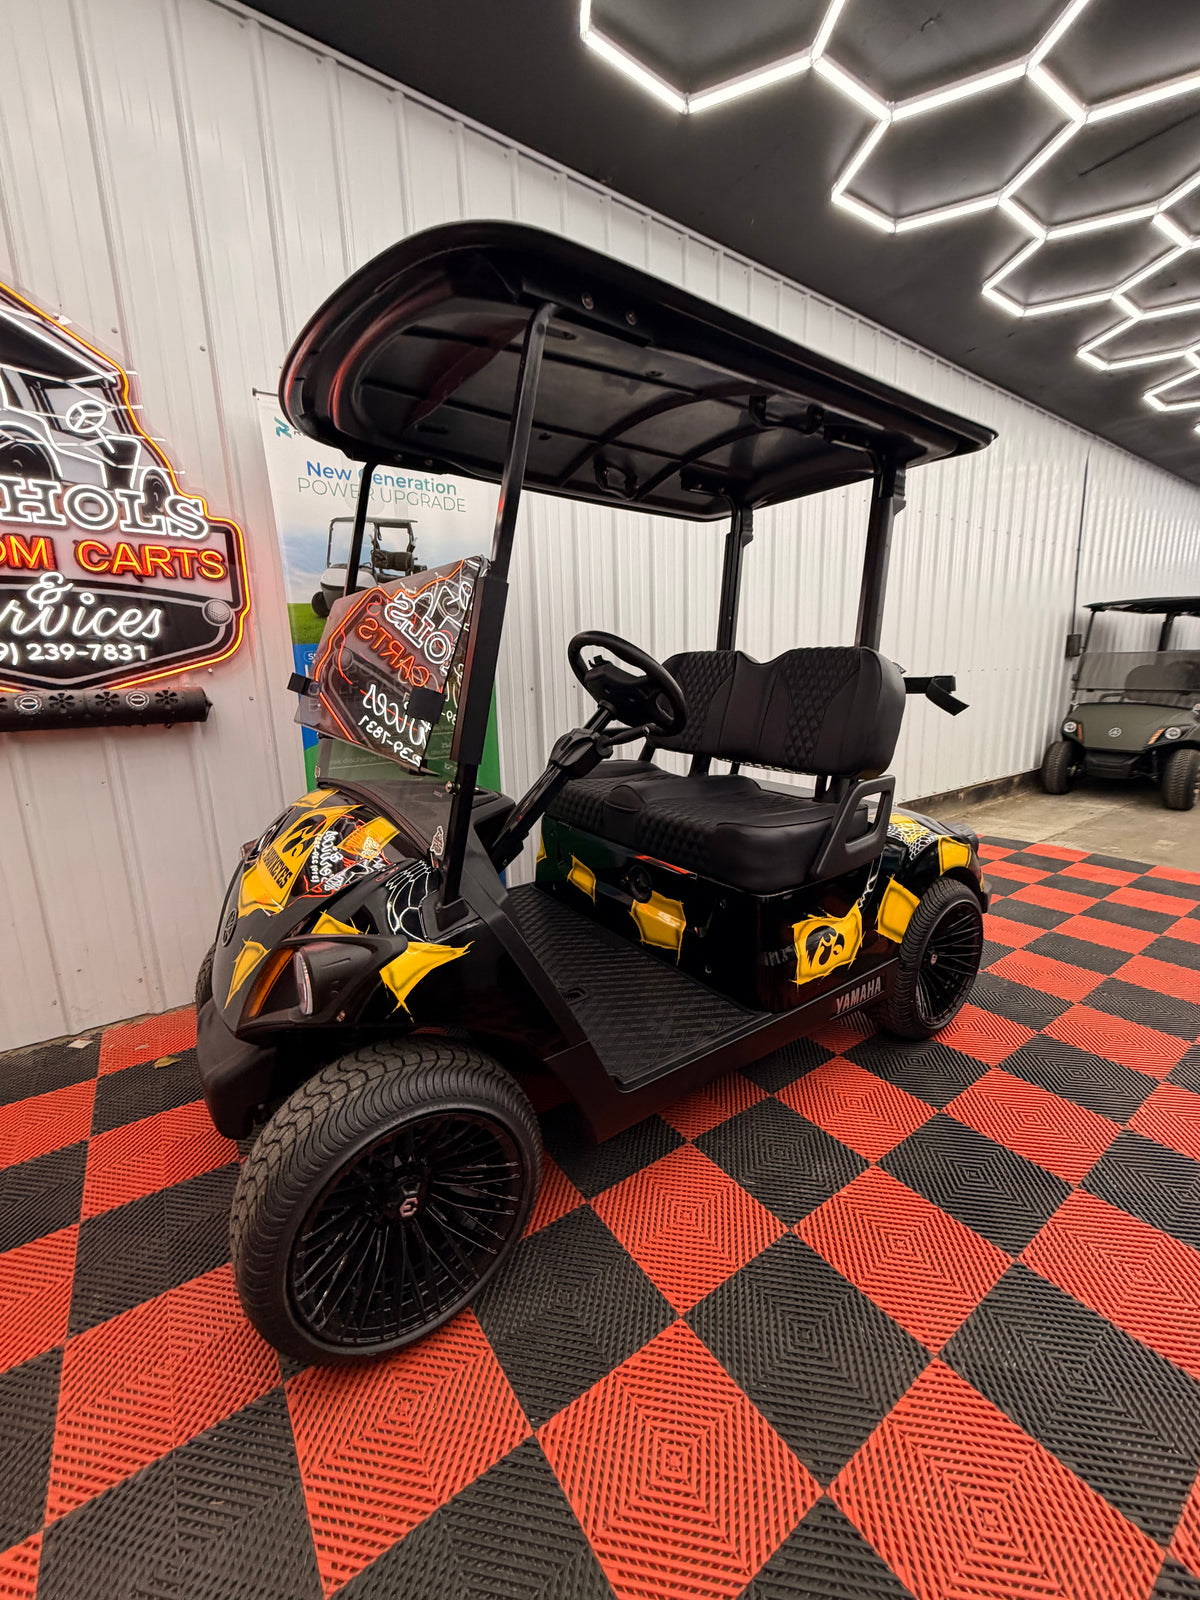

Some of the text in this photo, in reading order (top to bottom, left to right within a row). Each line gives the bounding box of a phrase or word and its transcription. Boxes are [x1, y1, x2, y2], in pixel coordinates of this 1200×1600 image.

[306, 460, 457, 496] New eneration
[380, 487, 466, 513] UPGRADE
[76, 539, 226, 581] CARTS
[26, 571, 74, 611] &
[25, 642, 147, 662] 239-7831
[836, 976, 882, 1014] YAMAHA
